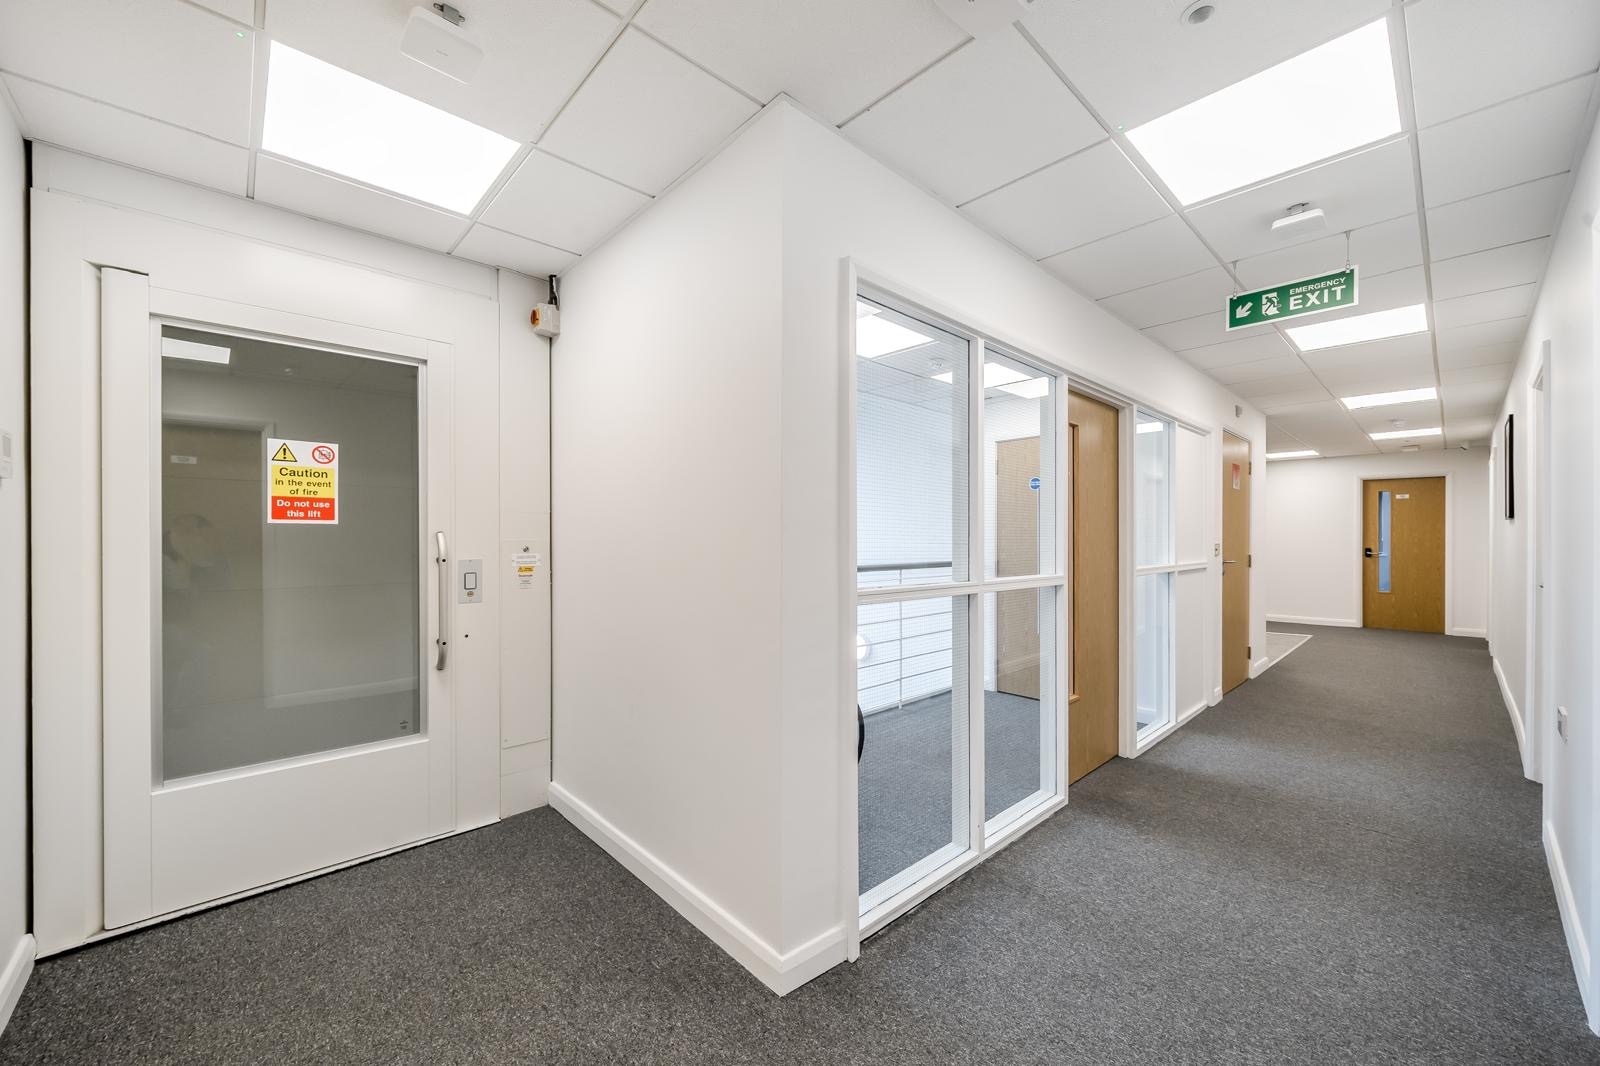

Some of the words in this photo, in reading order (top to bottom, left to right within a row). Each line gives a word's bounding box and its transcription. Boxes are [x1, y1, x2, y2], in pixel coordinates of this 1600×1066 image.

[1289, 277, 1346, 295] EMERGENCY
[1289, 285, 1346, 311] EXIT
[279, 467, 328, 479] Caution
[276, 499, 291, 507] Do
[294, 500, 310, 508] not
[308, 510, 321, 518] lift
